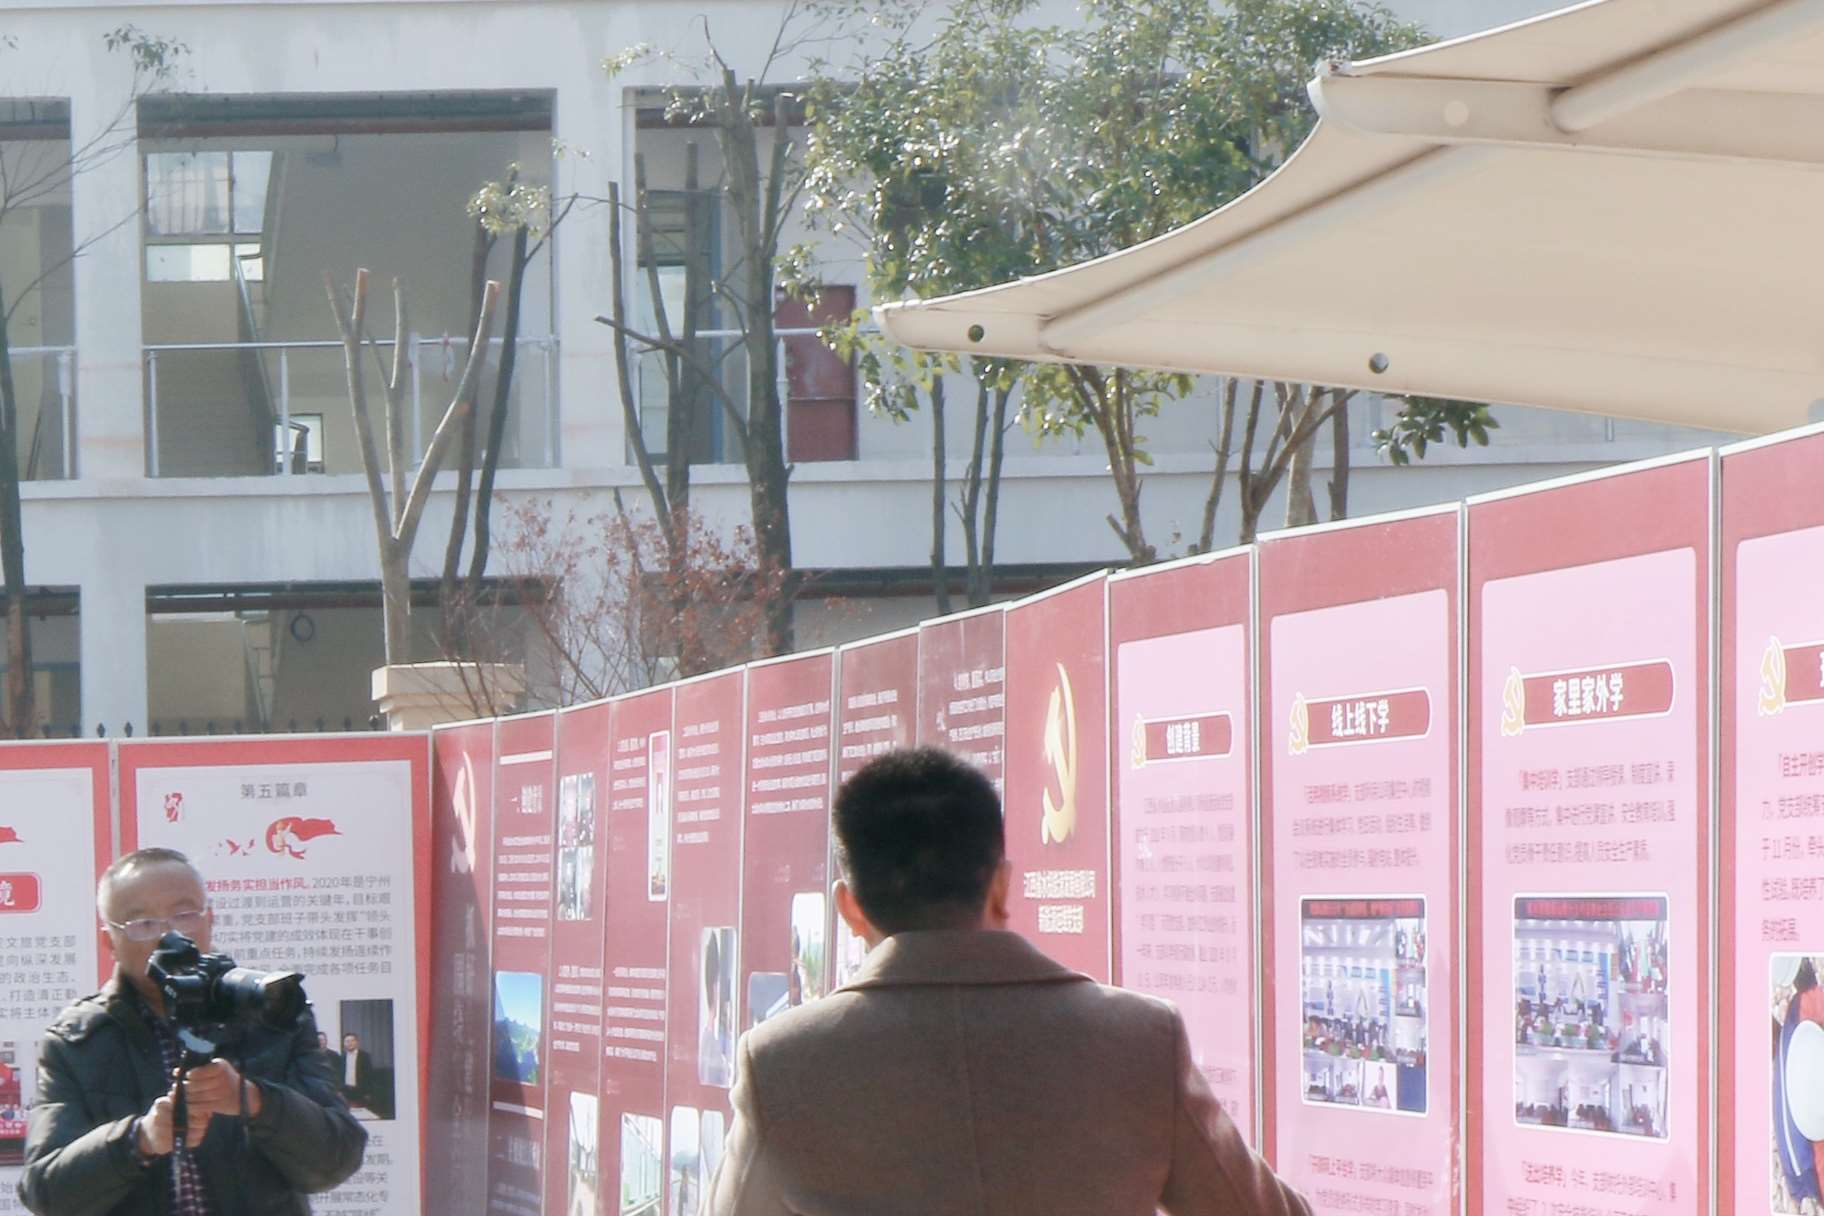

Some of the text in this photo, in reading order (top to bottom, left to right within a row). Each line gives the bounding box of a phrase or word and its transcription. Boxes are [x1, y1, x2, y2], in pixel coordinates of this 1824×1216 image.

[1553, 673, 1623, 716] 家里家外学
[241, 783, 307, 800] 第五篇章
